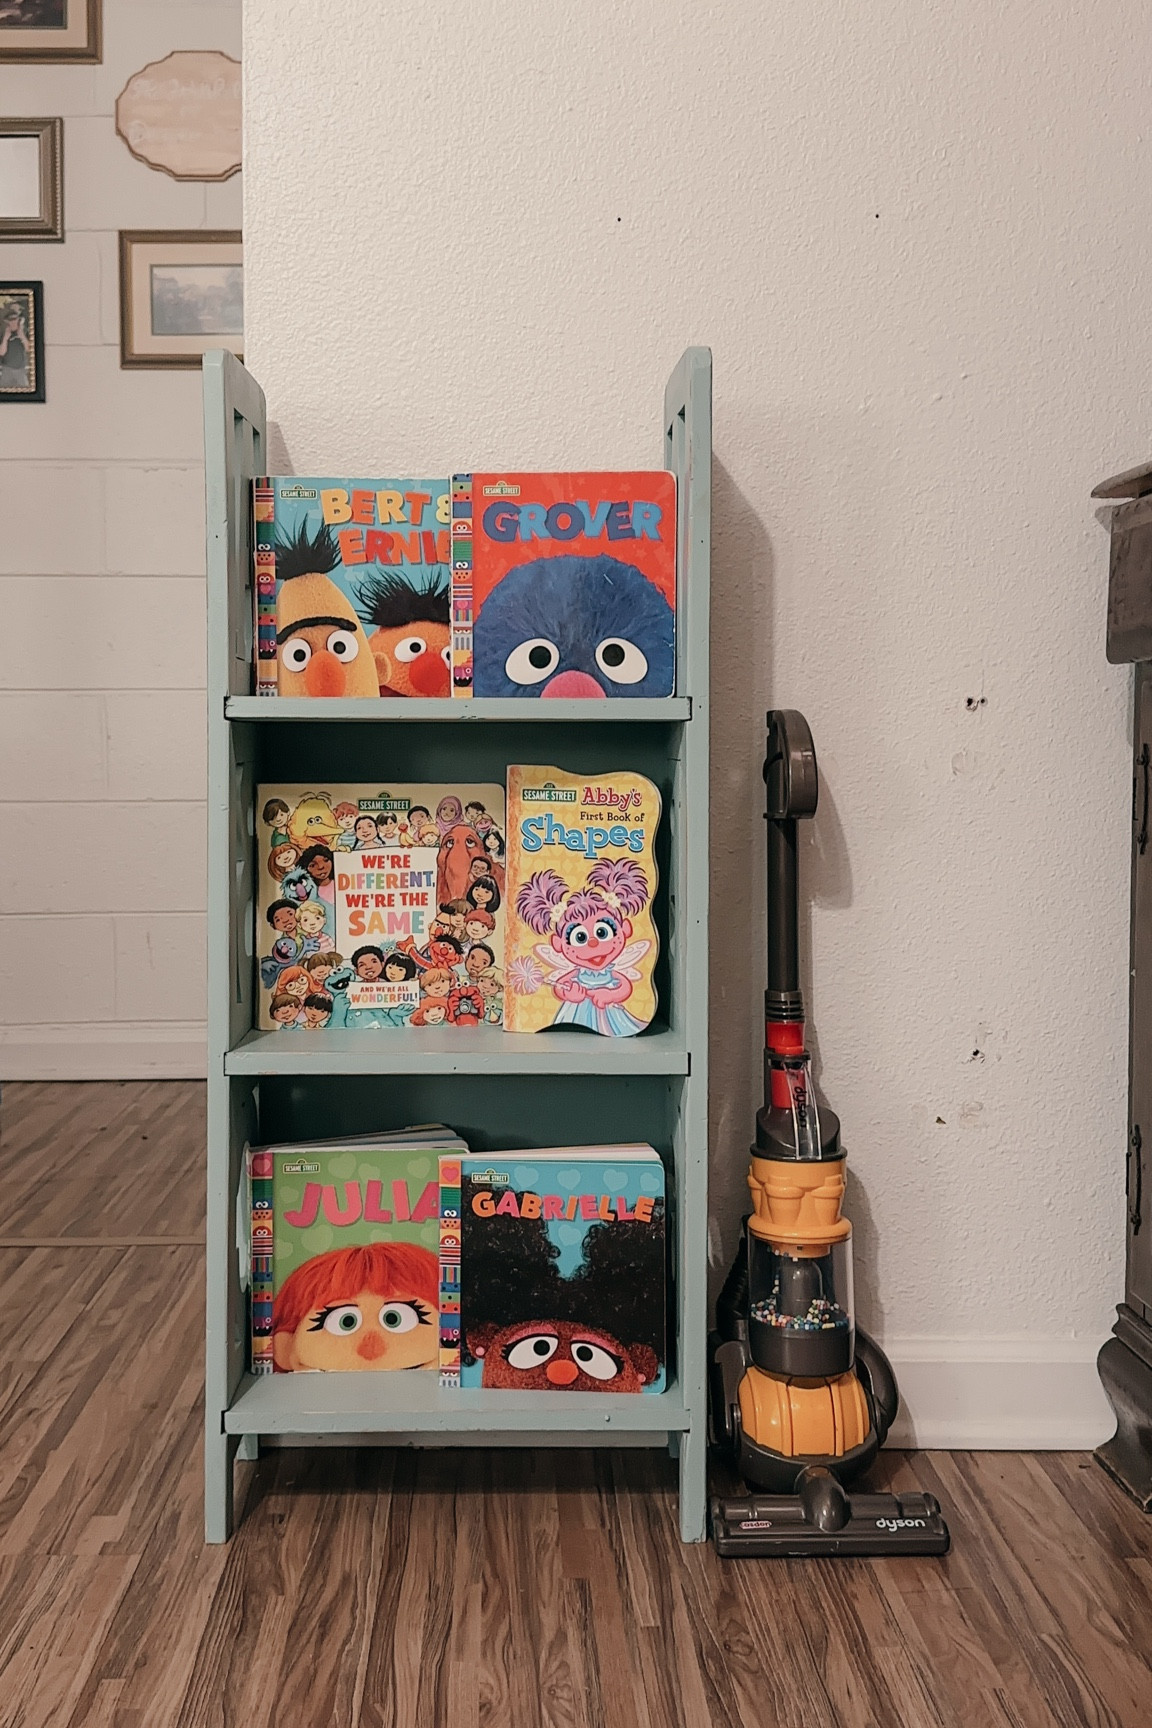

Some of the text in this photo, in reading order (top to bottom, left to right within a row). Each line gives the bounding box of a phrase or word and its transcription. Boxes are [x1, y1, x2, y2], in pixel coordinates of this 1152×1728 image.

[320, 488, 431, 525] BERT
[482, 500, 663, 542] GROVER
[360, 800, 409, 810] SESAME STREET
[523, 790, 576, 801] SESAME STREET
[581, 786, 643, 812] Abby's
[580, 811, 645, 822] First Book of
[521, 813, 645, 860] Shapes
[361, 854, 411, 869] WE'RE
[337, 870, 436, 892] DIFFERENT,
[345, 892, 429, 908] WE'RE THE
[348, 910, 425, 937] SAME
[351, 992, 418, 1003] WONDERFUL!
[793, 1086, 807, 1127] dyson
[283, 1179, 440, 1228] JULIA
[471, 1190, 655, 1224] GABRIELLE
[876, 1518, 926, 1532] dyson
